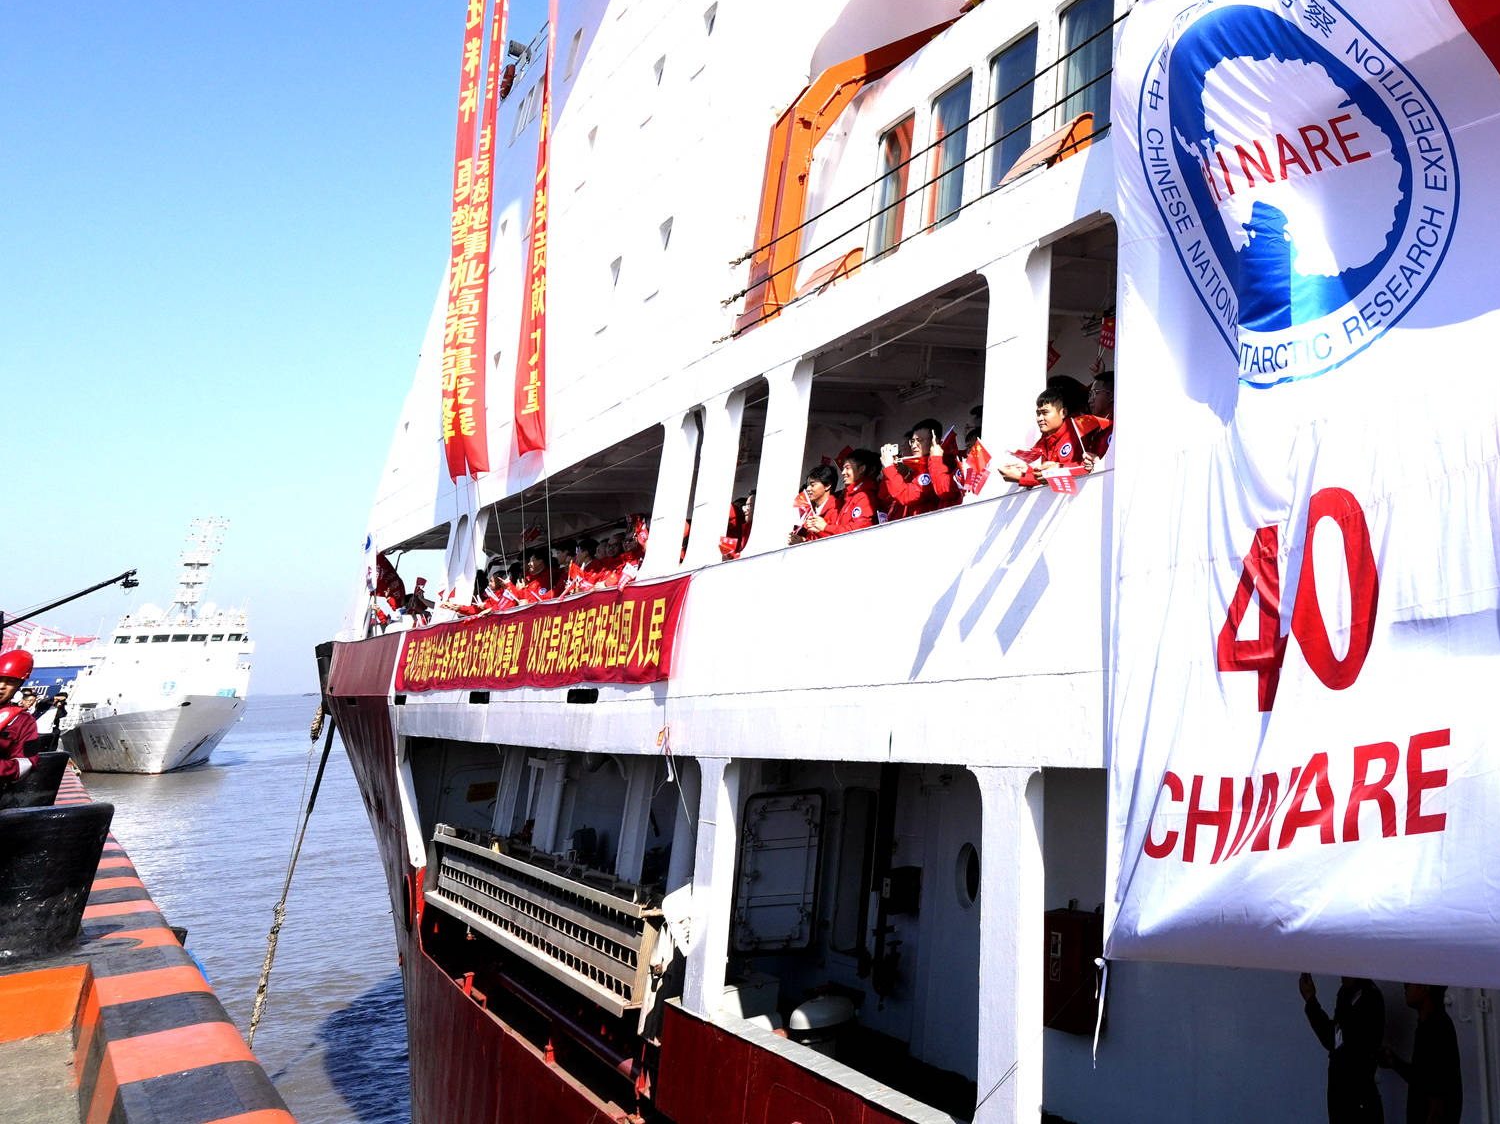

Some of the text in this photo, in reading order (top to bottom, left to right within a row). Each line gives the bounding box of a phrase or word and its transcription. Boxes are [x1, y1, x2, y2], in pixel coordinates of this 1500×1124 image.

[1145, 38, 1448, 374] CHINESE NATIONA TARCTIC RESEARCH EXPEDITION
[526, 598, 666, 675] 以优异成绩回报祖国人民
[1218, 486, 1379, 712] 40
[1144, 728, 1451, 865] CHINARE
